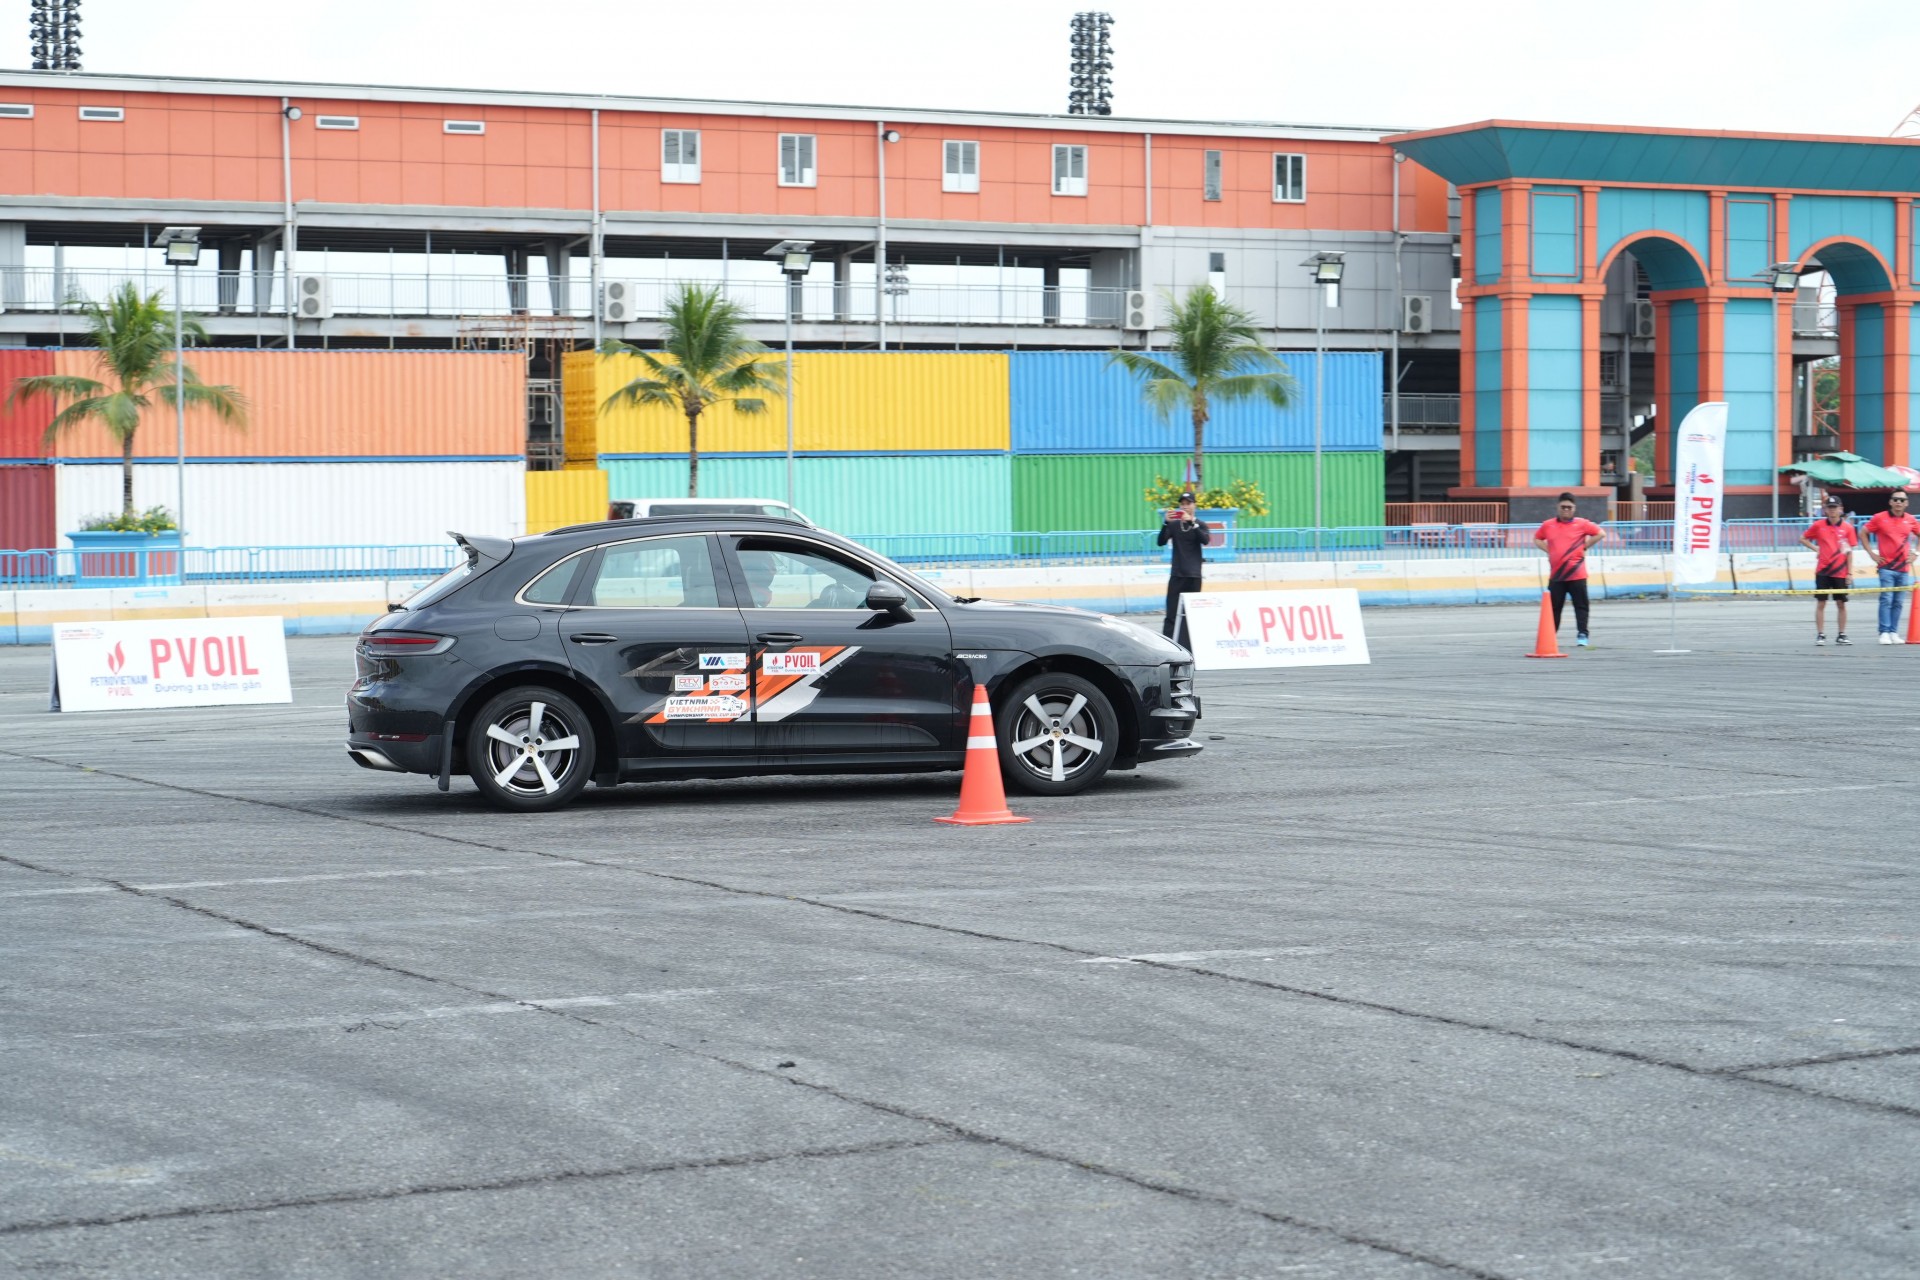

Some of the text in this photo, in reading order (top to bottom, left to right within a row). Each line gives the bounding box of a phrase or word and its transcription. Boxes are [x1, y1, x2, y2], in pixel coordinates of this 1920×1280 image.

[1690, 497, 1714, 554] PVOIL
[1259, 605, 1344, 642] PVOIL
[150, 636, 259, 679] PVOIL
[785, 655, 816, 668] PVOIL
